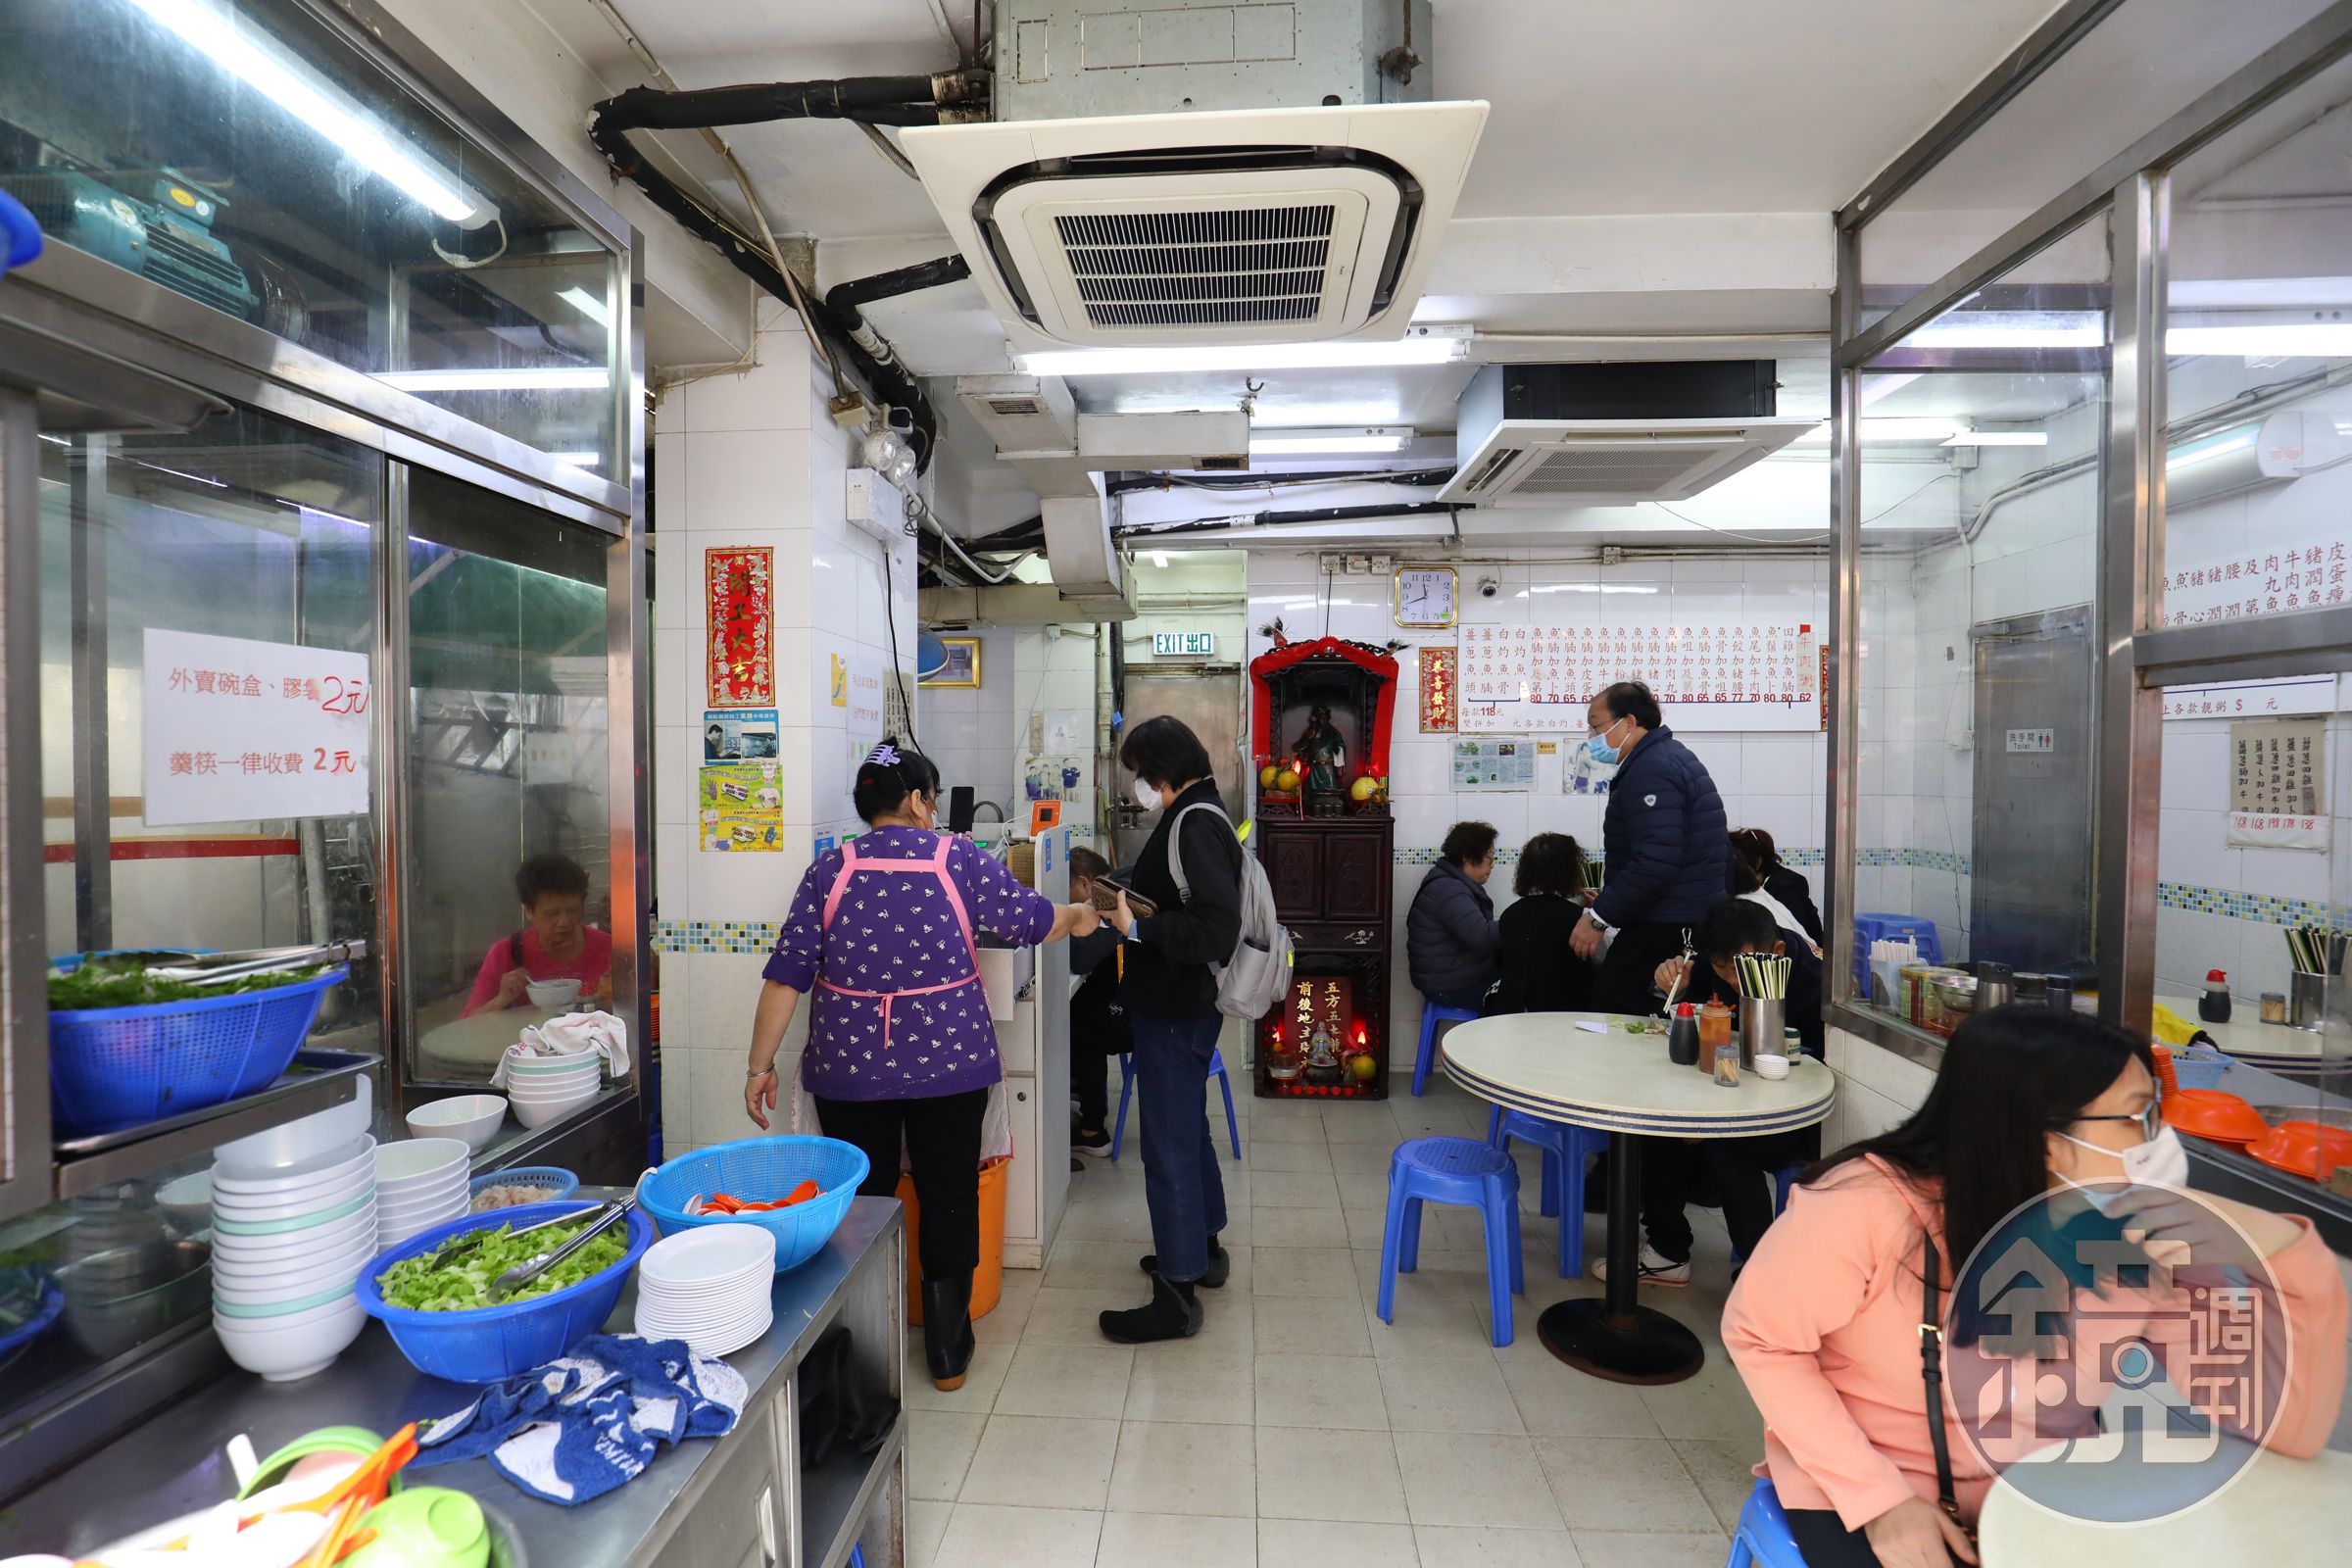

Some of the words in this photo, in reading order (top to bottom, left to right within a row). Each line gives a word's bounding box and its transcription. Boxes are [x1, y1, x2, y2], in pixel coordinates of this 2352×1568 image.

[728, 570, 754, 682] 開工大吉
[1156, 633, 1184, 653] EXIT
[1187, 633, 1211, 653] 出口
[1431, 659, 1446, 719] 恭喜發財
[1530, 694, 1542, 703] 80
[1548, 694, 1559, 703] 70
[1564, 694, 1576, 703] 65
[1664, 694, 1676, 703] 70
[1682, 694, 1693, 703] 80
[1697, 693, 1709, 702] 65
[1715, 693, 1727, 702] 65
[1732, 693, 1743, 702] 77
[1749, 693, 1760, 702] 70
[1764, 693, 1776, 702] 80
[1782, 693, 1793, 702] 80
[1799, 693, 1811, 702] 62
[2235, 699, 2243, 711] $
[2266, 697, 2278, 710] 元
[2010, 733, 2034, 742] 洗手間
[313, 747, 326, 771] 2
[330, 750, 356, 773] 元
